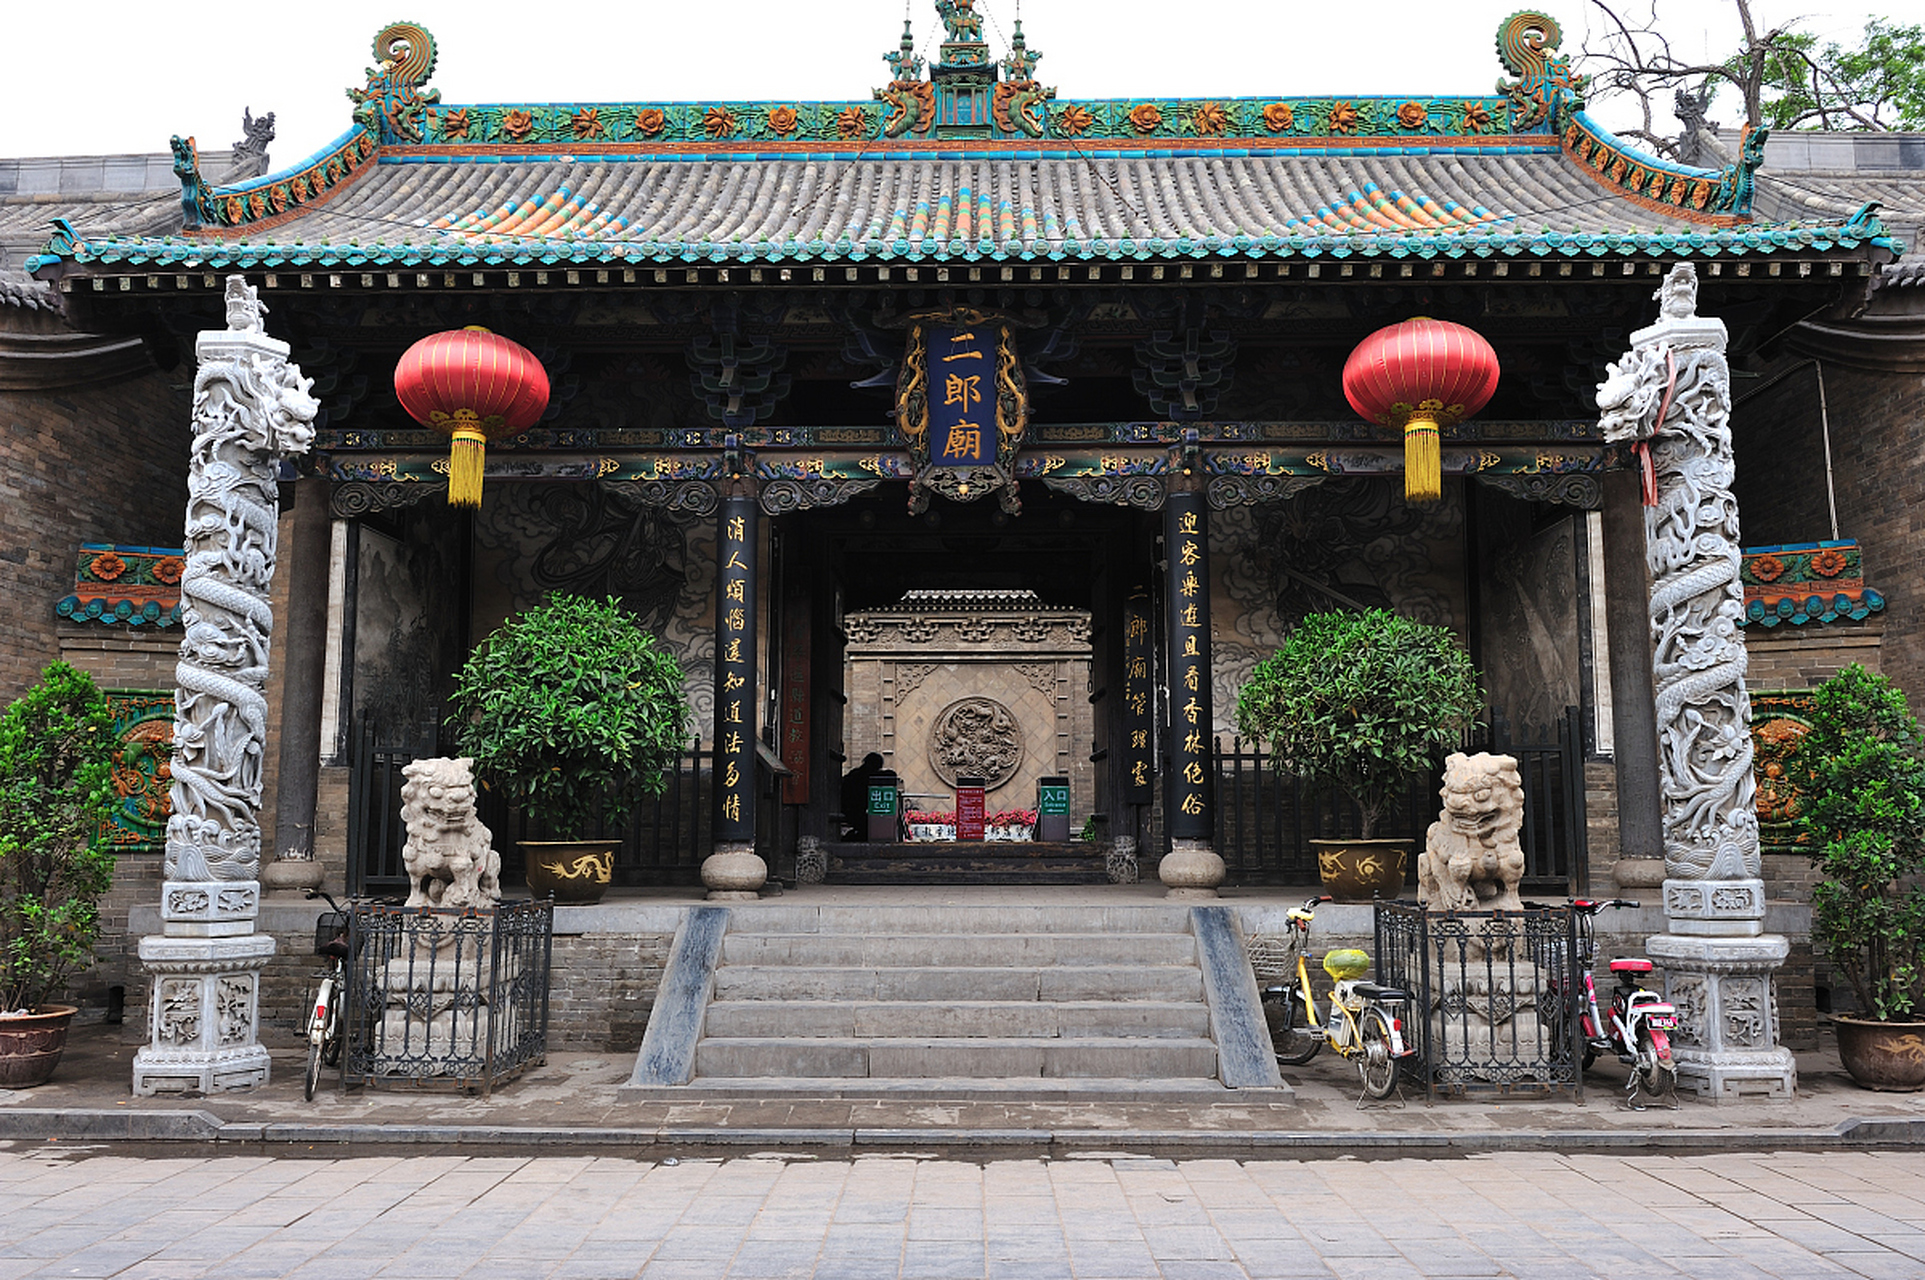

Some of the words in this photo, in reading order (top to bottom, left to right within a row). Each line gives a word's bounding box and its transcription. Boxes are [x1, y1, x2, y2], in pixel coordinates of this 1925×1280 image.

[942, 332, 983, 460] 二郎廟
[870, 789, 894, 802] 出口
[1043, 789, 1067, 802] 入口
[873, 801, 890, 809] Exit
